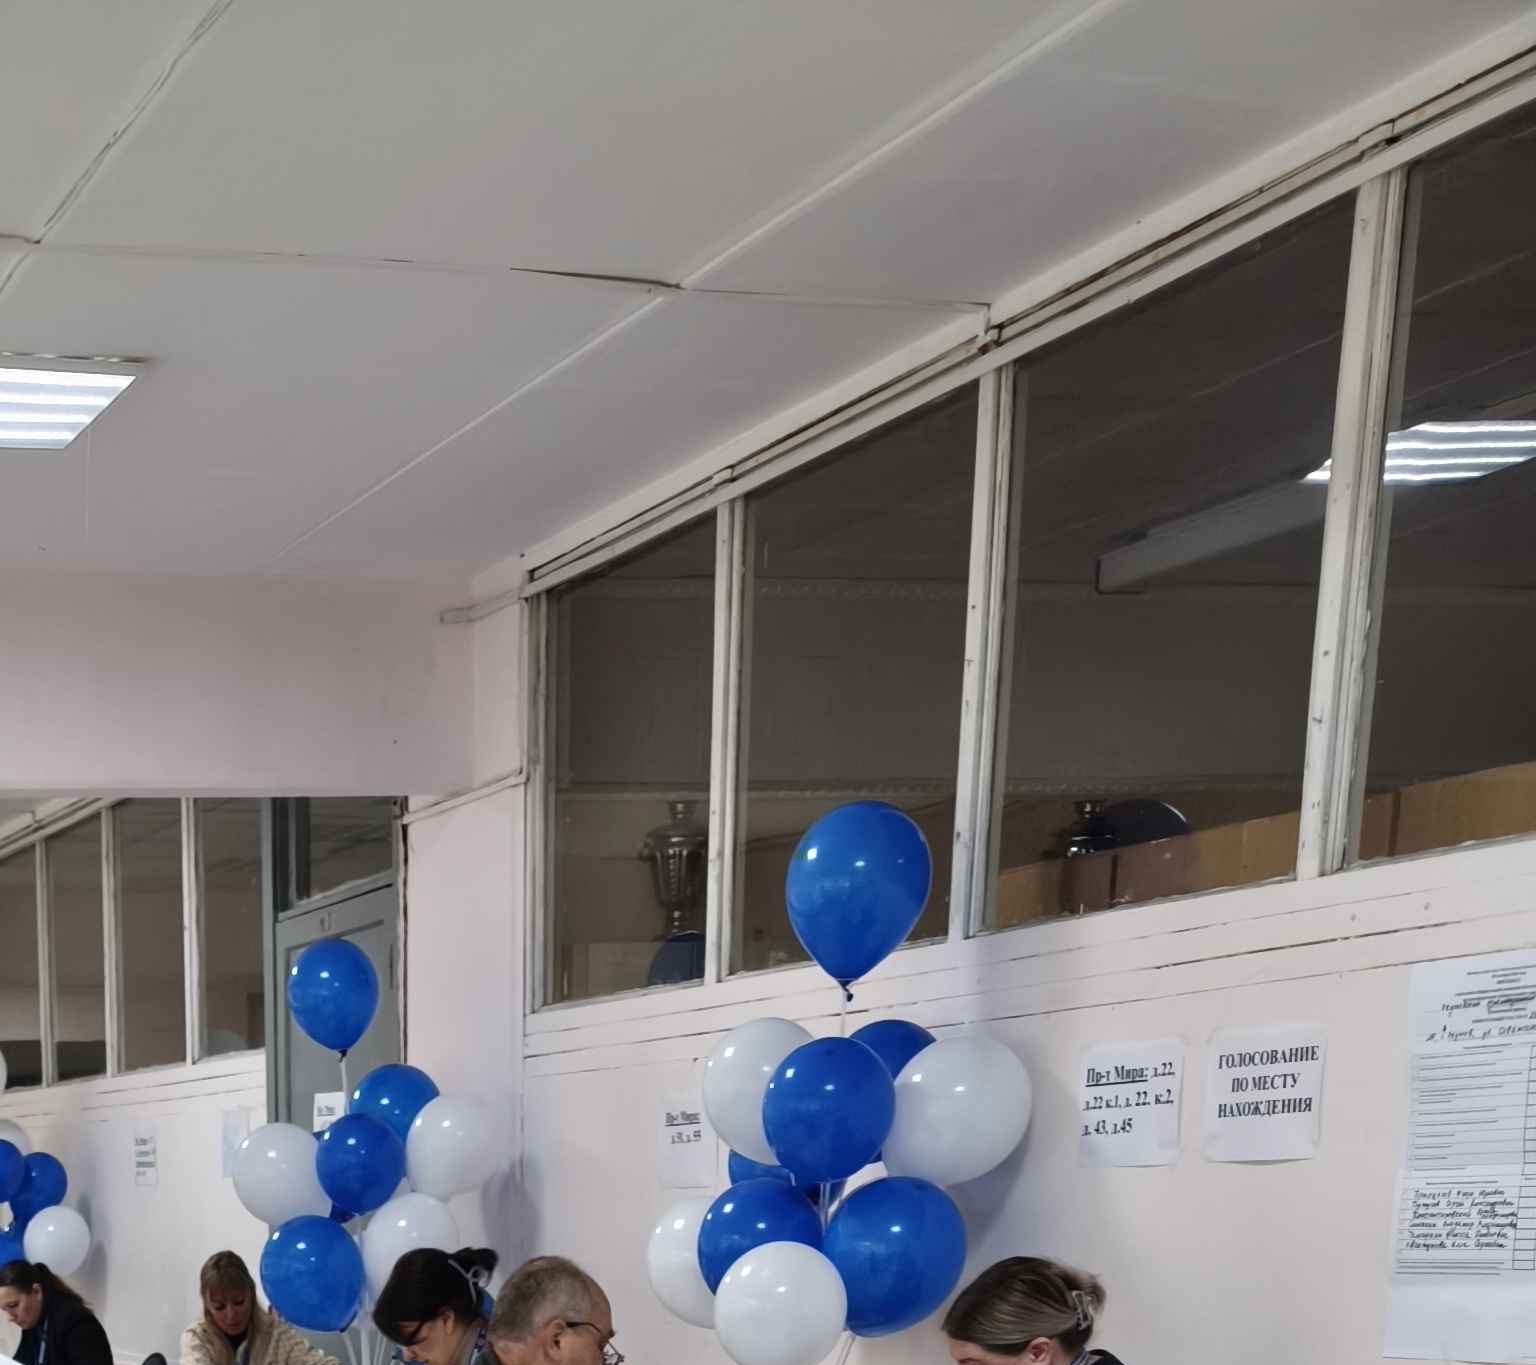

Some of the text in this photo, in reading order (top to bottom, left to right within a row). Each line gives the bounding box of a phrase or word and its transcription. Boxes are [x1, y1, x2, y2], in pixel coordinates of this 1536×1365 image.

[1218, 1045, 1320, 1069] ГОЛОСОВАНИЕ
[1086, 1067, 1111, 1084] Пр-т
[1114, 1065, 1149, 1082] Мира:
[1231, 1073, 1301, 1093] ПО МЕСТУ
[1218, 1096, 1313, 1118] НАХОЖДЕНИЯ
